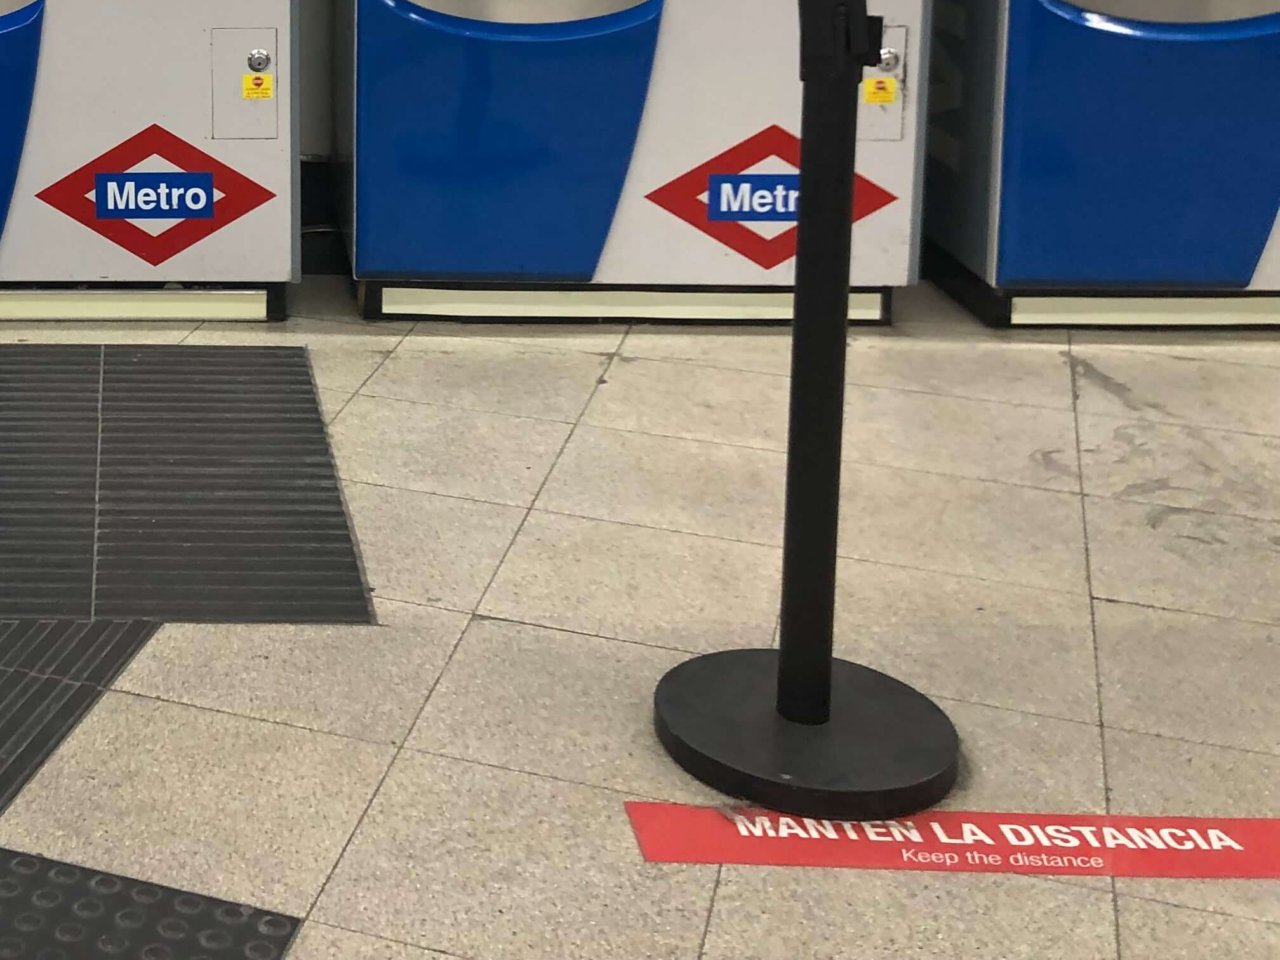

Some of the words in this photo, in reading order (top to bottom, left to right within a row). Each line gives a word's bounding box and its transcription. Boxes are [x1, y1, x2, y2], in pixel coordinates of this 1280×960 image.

[106, 181, 207, 210] Metro
[720, 183, 800, 213] Metr
[930, 821, 996, 845] LA
[998, 824, 1244, 851] DISTANCIA
[901, 848, 959, 866] Keep
[965, 851, 1002, 865] the
[1009, 852, 1104, 868] distance
